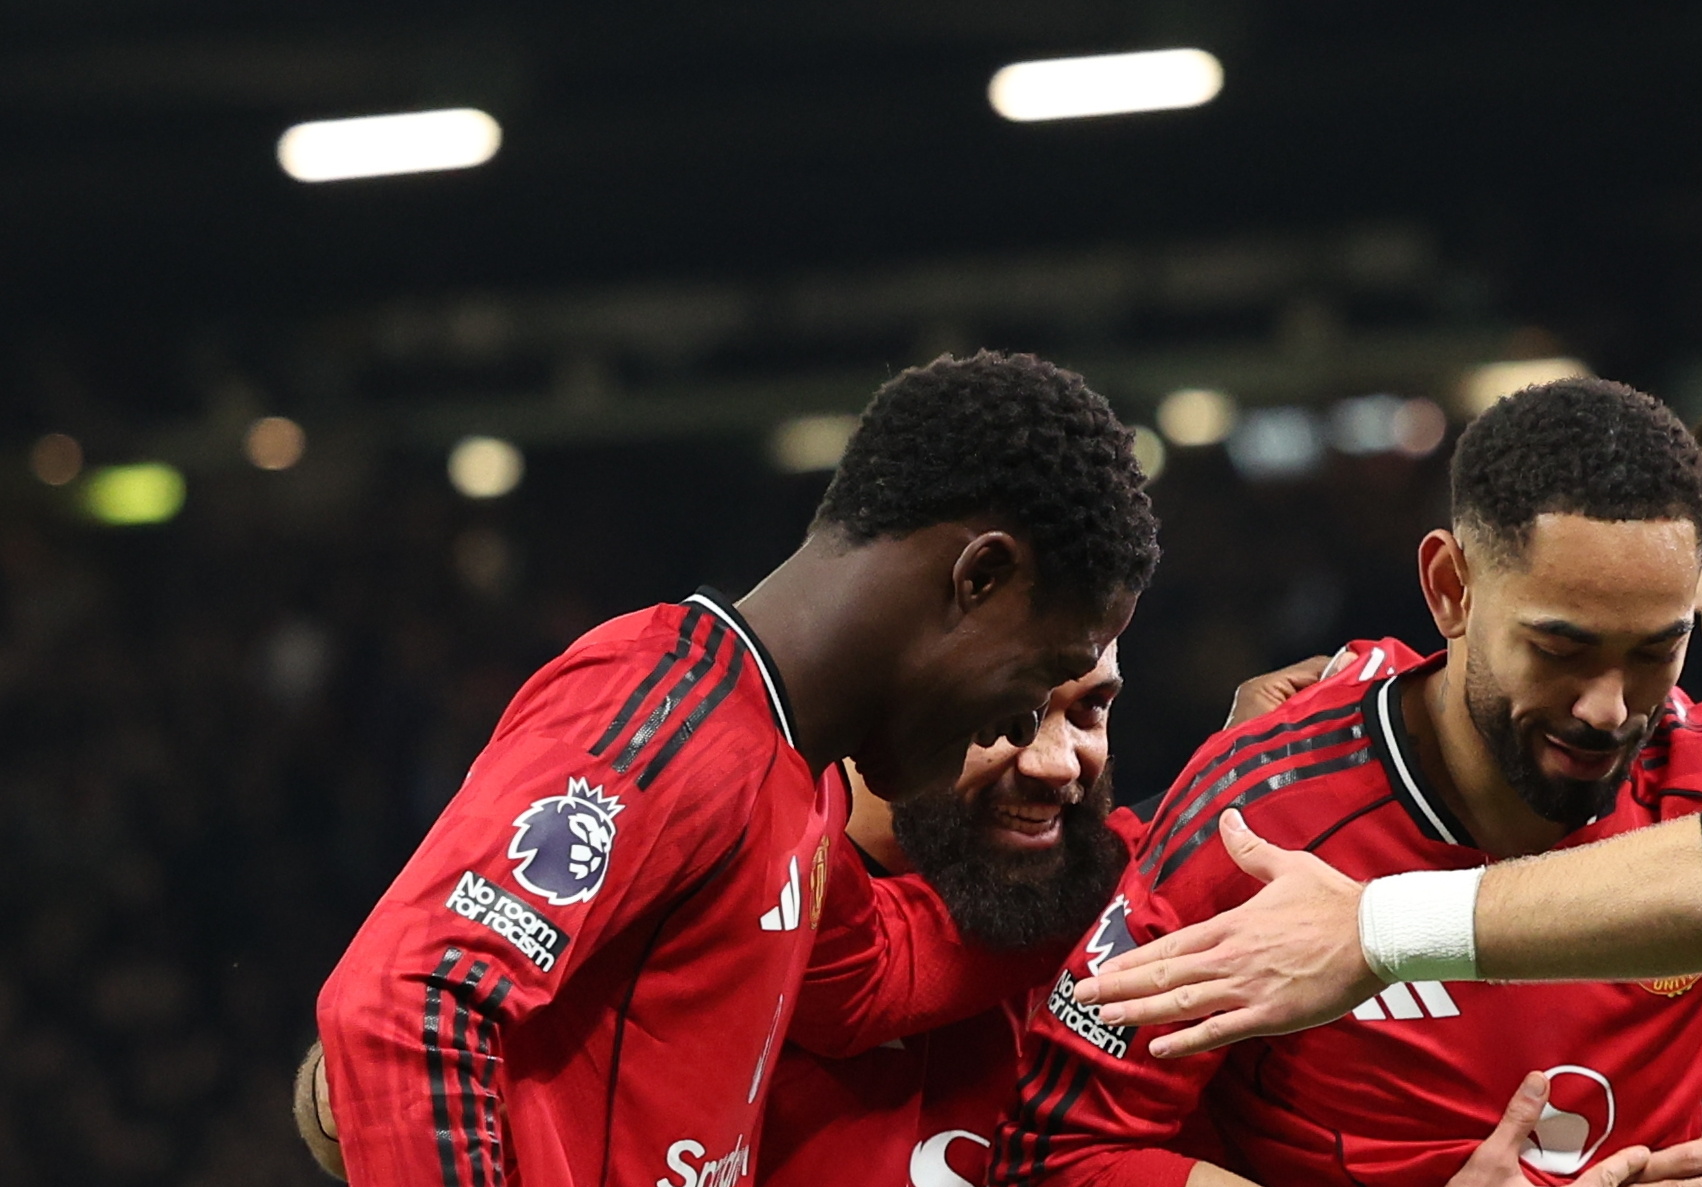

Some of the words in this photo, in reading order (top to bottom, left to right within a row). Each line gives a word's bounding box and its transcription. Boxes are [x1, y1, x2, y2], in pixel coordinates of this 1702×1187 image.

[445, 887, 487, 920] for
[481, 910, 555, 973] racism
[456, 870, 496, 905] No
[493, 895, 558, 950] room
[1058, 1003, 1127, 1059] racism
